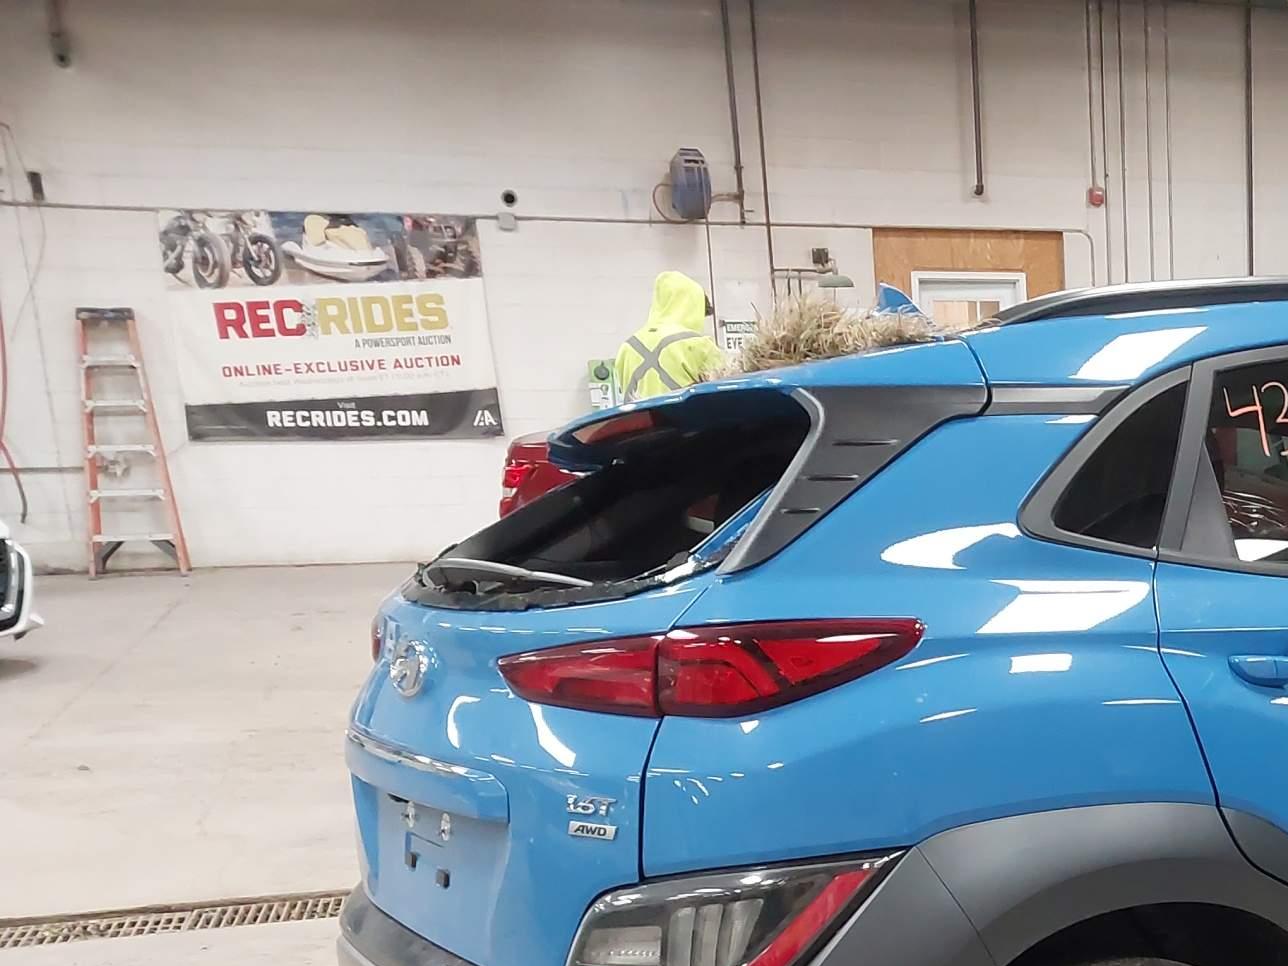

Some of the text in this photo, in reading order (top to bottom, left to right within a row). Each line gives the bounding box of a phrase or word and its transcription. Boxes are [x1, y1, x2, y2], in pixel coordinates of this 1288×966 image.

[212, 292, 449, 340] REC RIDES
[354, 334, 452, 349] A POWERSPORT AUCTION
[222, 354, 462, 378] ONLINE-EXCLUSIVE AUCTION
[266, 409, 430, 428] RECRIDES.COM
[574, 824, 607, 837] AWD
